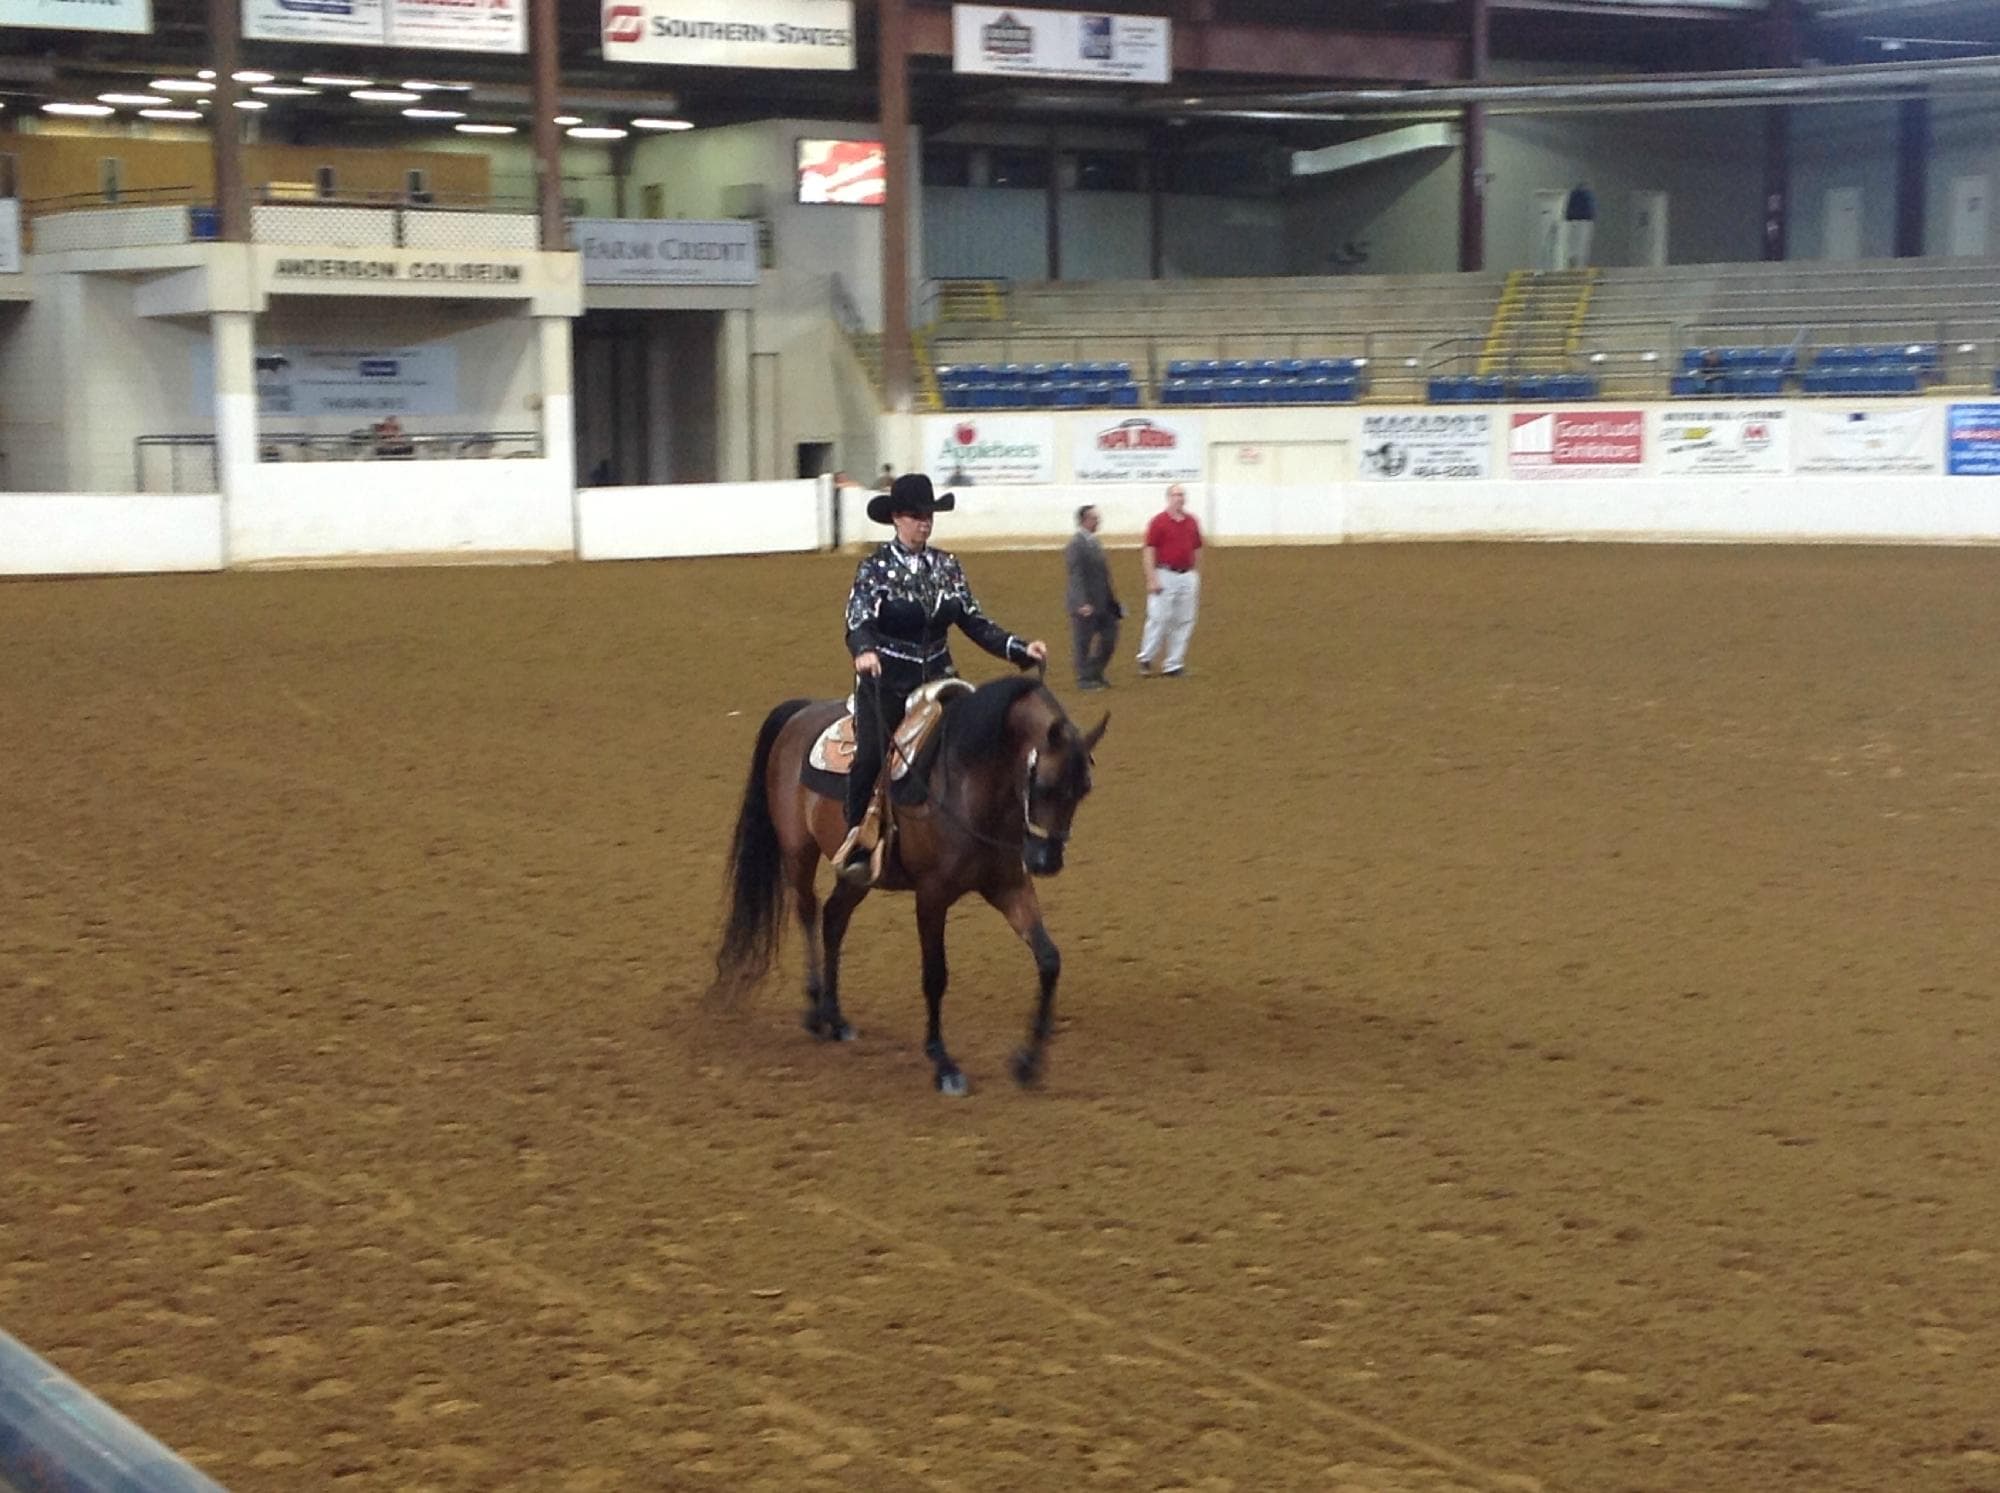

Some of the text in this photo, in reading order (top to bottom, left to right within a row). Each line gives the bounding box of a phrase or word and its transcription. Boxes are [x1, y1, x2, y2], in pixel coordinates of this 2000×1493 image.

[651, 16, 852, 46] SOUTHERN STATES
[657, 238, 748, 261] CREDIT
[275, 259, 521, 282] ANDERSON COLISEUM
[1556, 420, 1599, 437] Good
